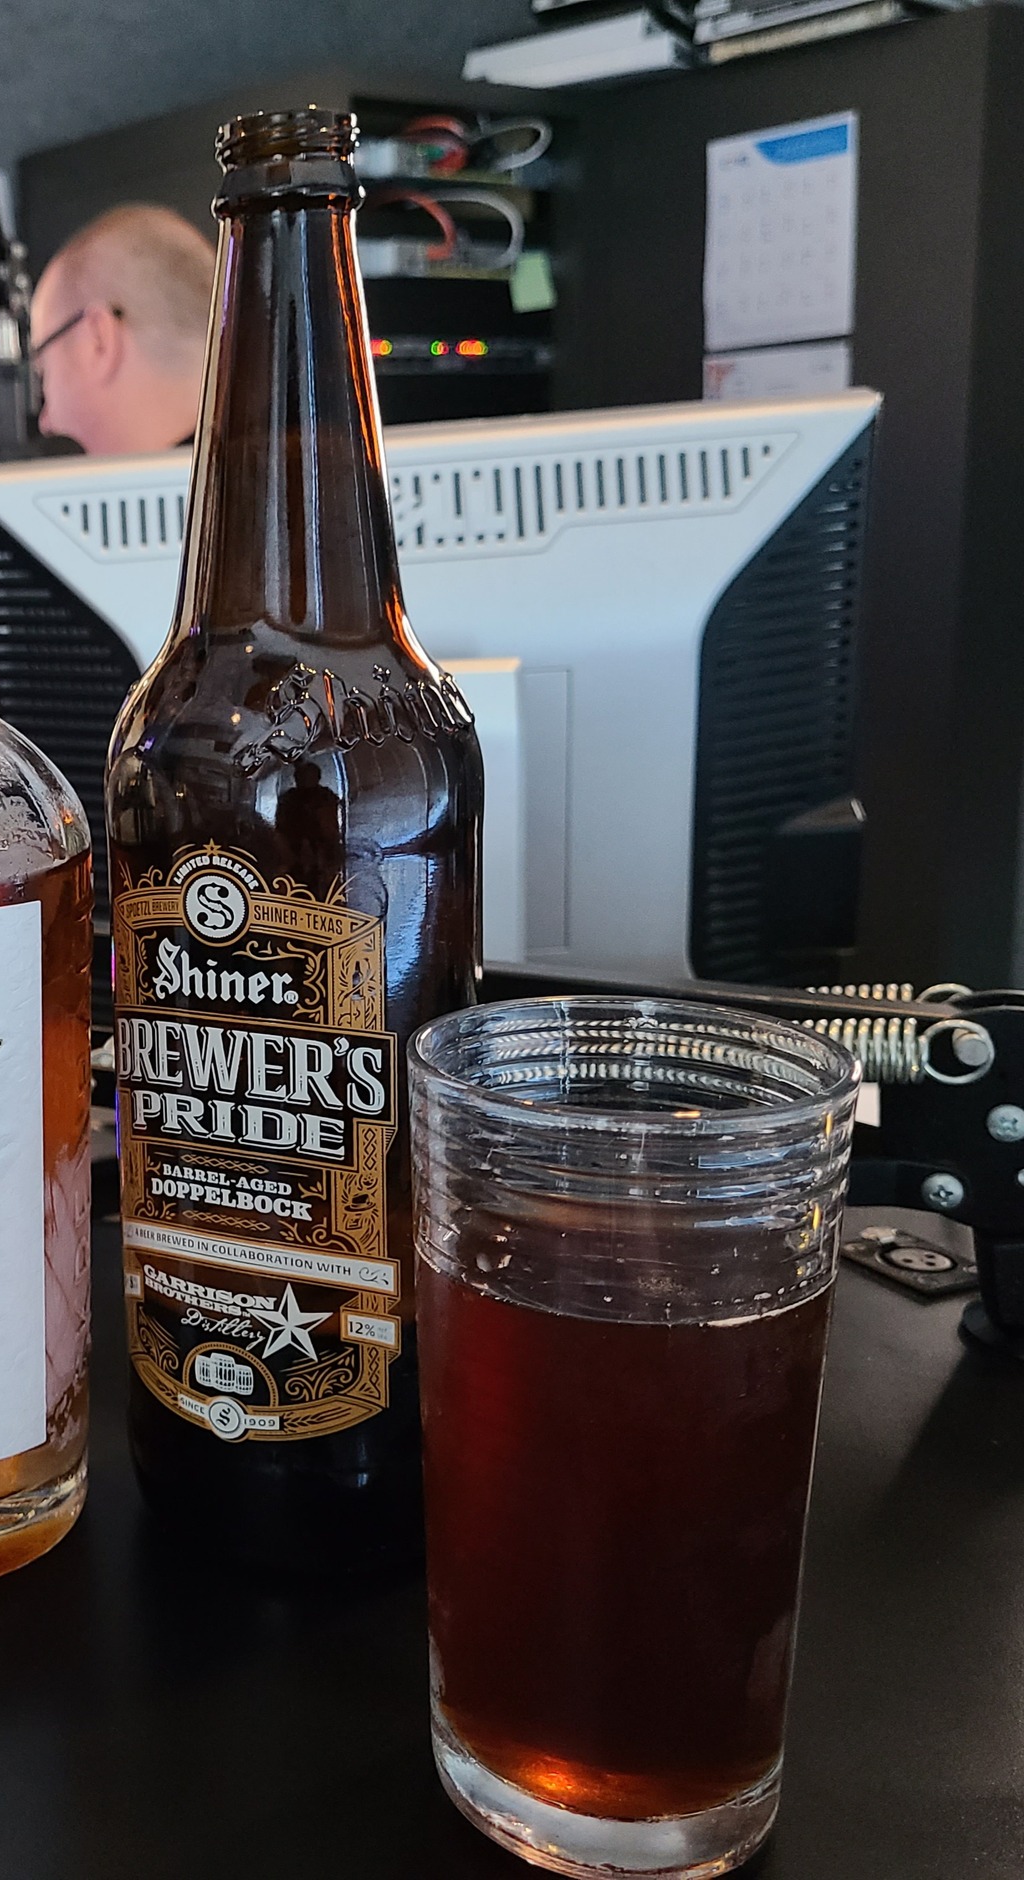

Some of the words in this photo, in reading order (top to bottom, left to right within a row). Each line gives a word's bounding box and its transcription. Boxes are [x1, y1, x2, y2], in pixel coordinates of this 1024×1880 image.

[173, 855, 211, 885] LIMITED
[212, 856, 259, 891] RELEASE
[126, 902, 151, 918] SPOETZL
[152, 899, 179, 912] BREWERY
[254, 904, 297, 926] SHINER
[306, 913, 343, 935] TEXAS
[117, 1018, 387, 1115] BREWER'S
[132, 1089, 345, 1160] PRIDE
[162, 1164, 292, 1196] BARREL-AGED
[151, 1178, 312, 1222] DOPPELBOCK
[140, 1228, 156, 1241] BEER
[156, 1232, 195, 1249] BREWED
[197, 1240, 209, 1251] IN
[211, 1243, 313, 1270] COLLABORATION
[317, 1261, 351, 1276] WITH
[143, 1264, 277, 1310] GARRISON
[181, 1307, 266, 1351] Distillery
[349, 1321, 376, 1337] 12%
[179, 1397, 206, 1415] SINCE
[244, 1418, 276, 1427] 1909
